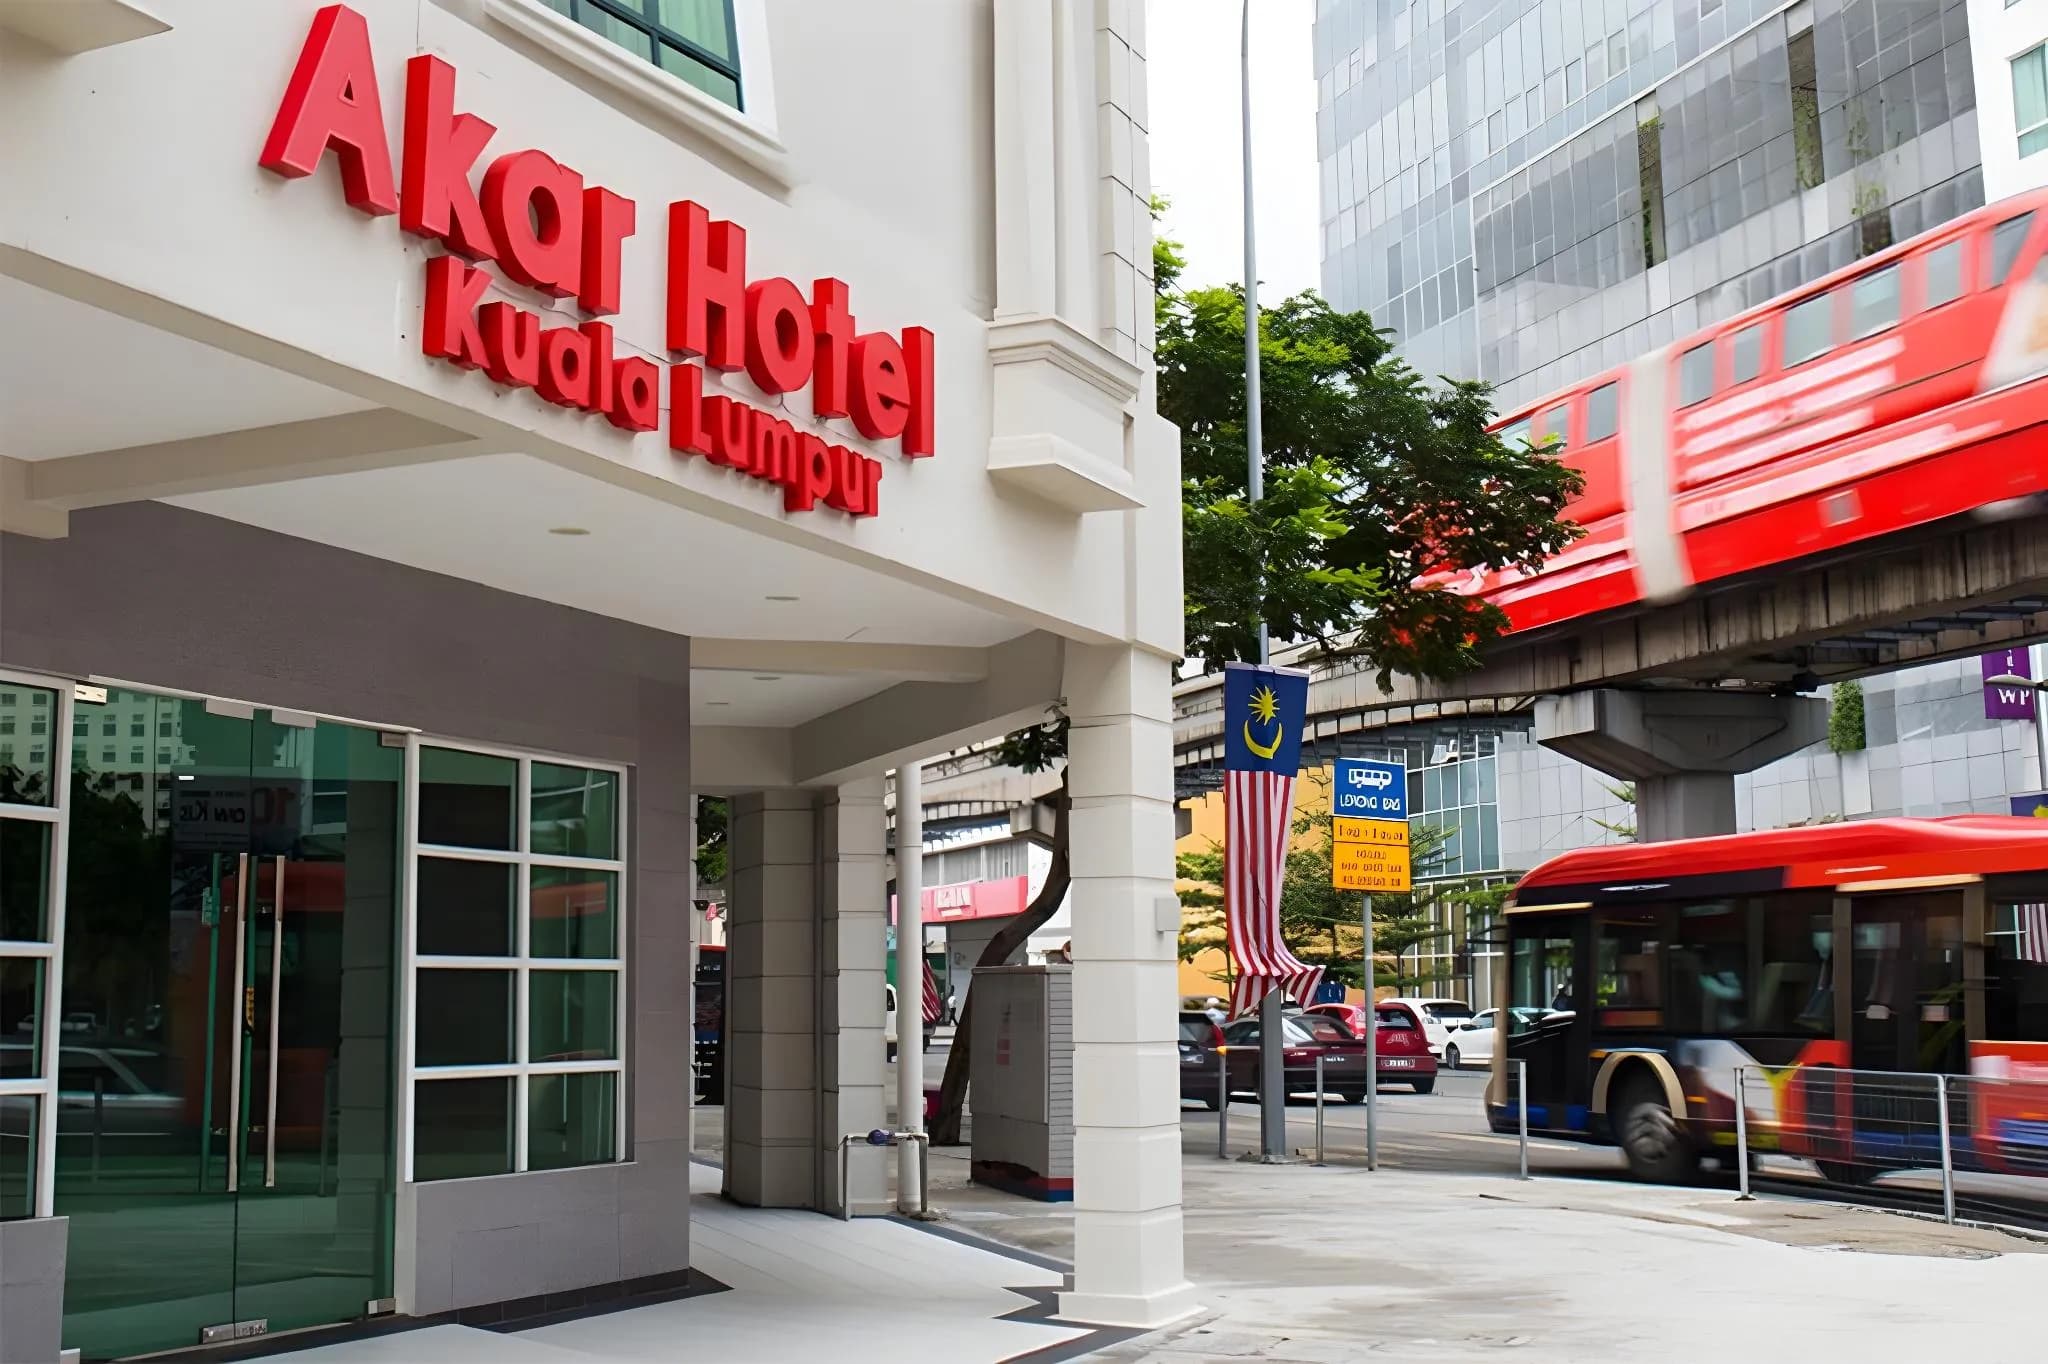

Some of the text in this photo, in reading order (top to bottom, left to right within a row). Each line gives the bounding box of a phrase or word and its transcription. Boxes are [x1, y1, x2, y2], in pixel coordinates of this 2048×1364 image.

[259, 3, 935, 459] Akar Hotel
[422, 255, 882, 517] Kuala Lumpur
